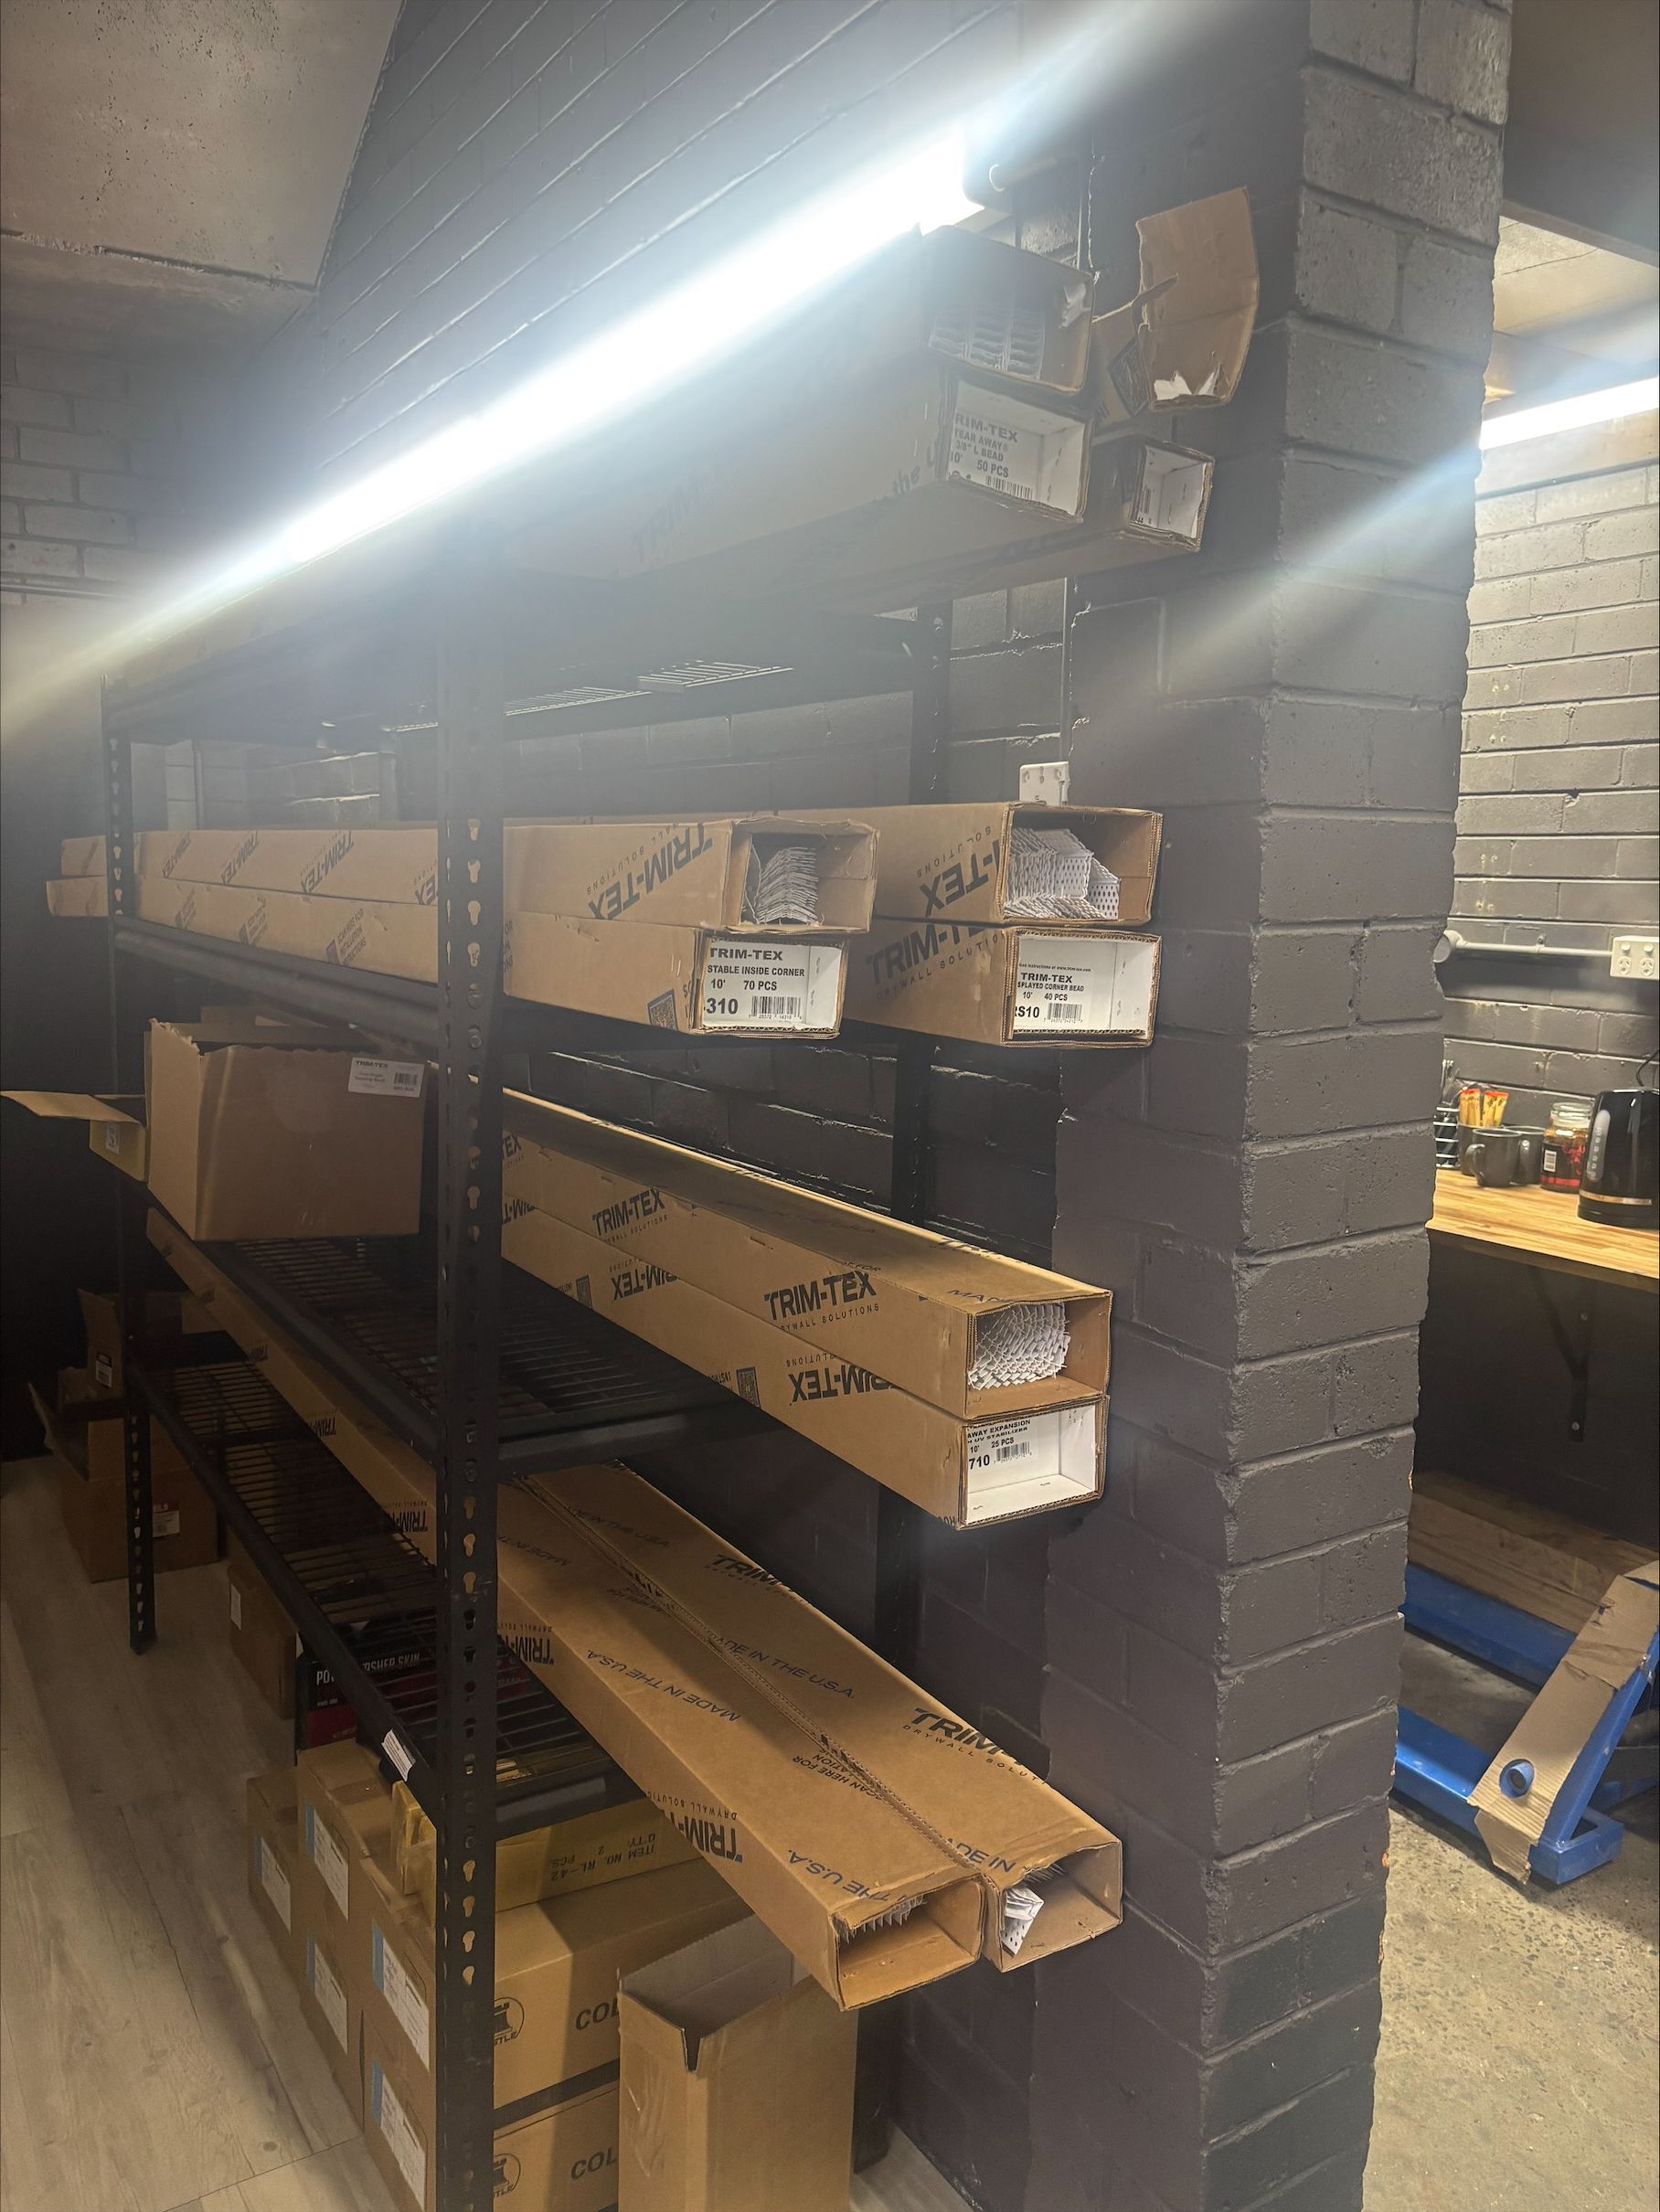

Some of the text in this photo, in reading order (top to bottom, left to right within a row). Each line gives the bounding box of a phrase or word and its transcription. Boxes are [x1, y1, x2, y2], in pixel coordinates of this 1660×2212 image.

[955, 413, 1017, 442] RIM-TEX
[981, 448, 1004, 462] BEAD
[977, 459, 988, 472] 50
[991, 463, 1009, 478] PCS
[586, 845, 644, 896] SOLUTIONS
[588, 823, 713, 920] TRIM-TEX
[710, 948, 782, 962] TRIM-TEX
[708, 964, 804, 977] STABLE INSIDE CORNER
[1020, 973, 1073, 984] TRIM-TEX
[710, 978, 777, 991] 10' 70 PCS
[1016, 981, 1044, 989] SPLAYED
[1045, 983, 1069, 991] CORNER
[704, 997, 739, 1015] 310
[591, 1188, 665, 1237] TRIM-TEX
[764, 1270, 877, 1321] TRIM-TEX
[822, 1303, 879, 1324] SOLUTIONS
[987, 1427, 1027, 1440] STABILIZER
[990, 1420, 1031, 1433] EXPANSION
[991, 1441, 999, 1449] 25
[1001, 1437, 1015, 1446] PCS
[748, 1650, 769, 1662] IN
[771, 1658, 810, 1678] THE
[625, 1668, 663, 1689] THE
[664, 1684, 686, 1697] IN
[683, 1693, 741, 1723] MADE
[902, 1724, 974, 1758] DRYWALL
[793, 1755, 819, 1771] FOR
[817, 1767, 850, 1784] HERE
[690, 1801, 738, 1821] DRYWALL
[628, 1844, 655, 1860] ITEM
[988, 1856, 1017, 1873] IN
